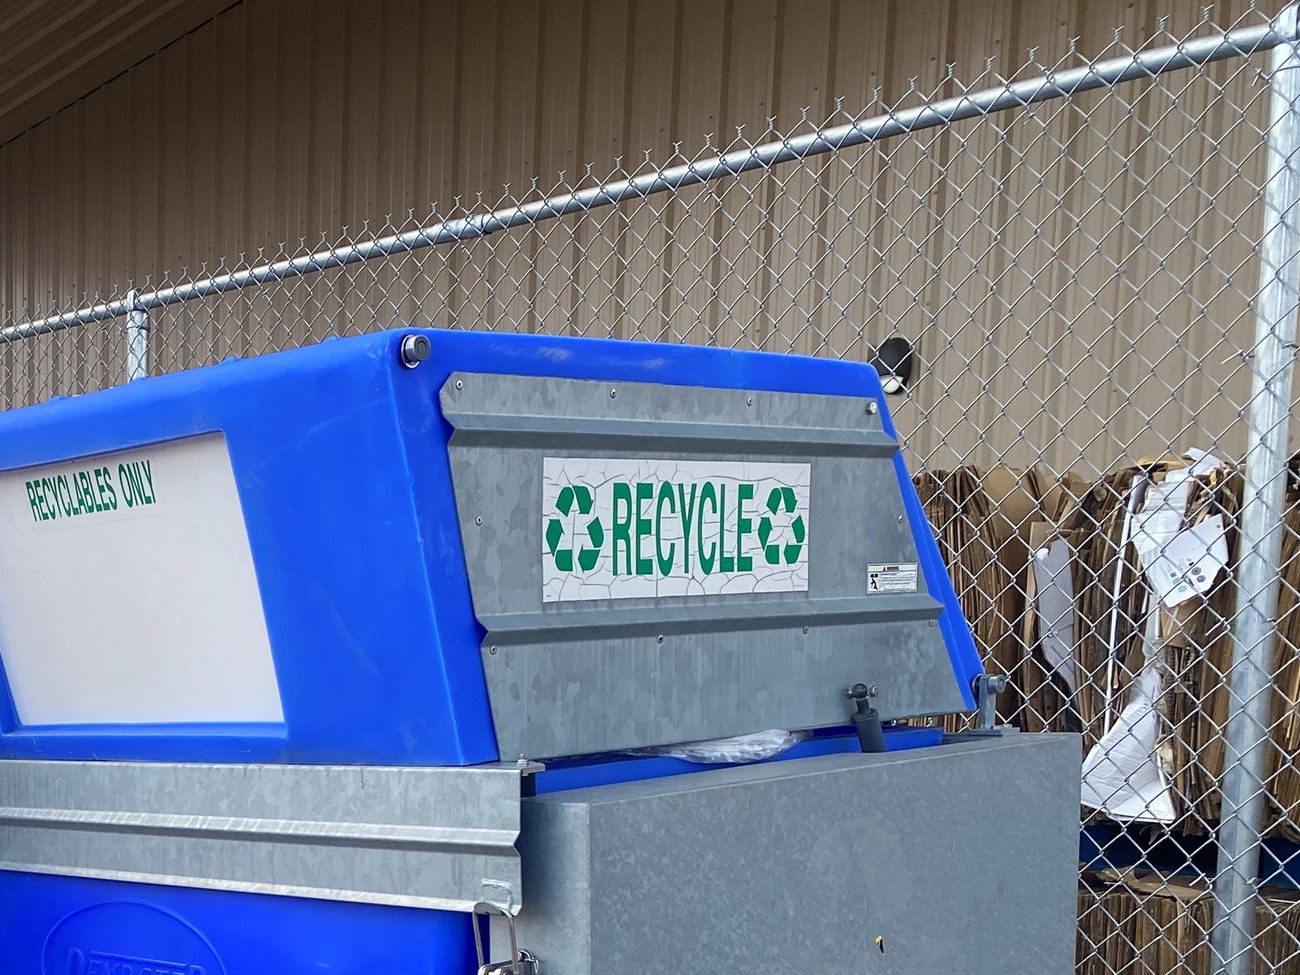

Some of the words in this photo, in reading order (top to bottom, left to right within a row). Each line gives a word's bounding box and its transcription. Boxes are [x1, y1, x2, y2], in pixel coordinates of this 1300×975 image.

[26, 467, 118, 521] RECYCLABLES
[118, 460, 156, 508] ONLY
[613, 480, 754, 576] RECYCLE
